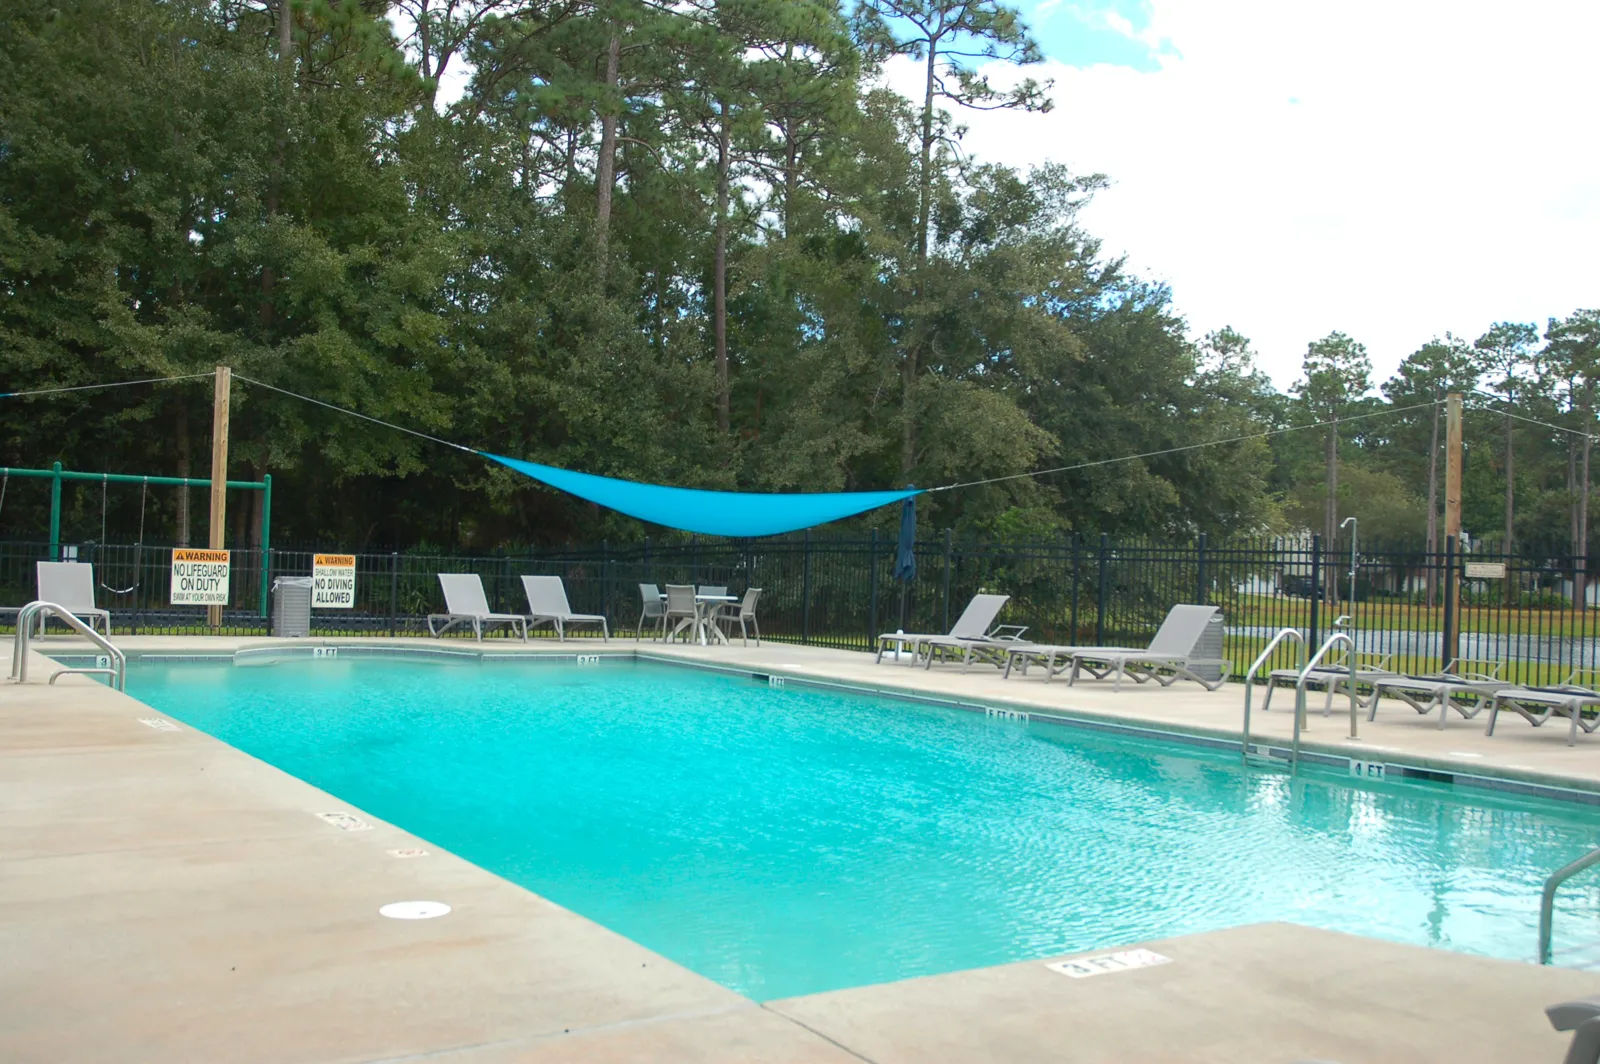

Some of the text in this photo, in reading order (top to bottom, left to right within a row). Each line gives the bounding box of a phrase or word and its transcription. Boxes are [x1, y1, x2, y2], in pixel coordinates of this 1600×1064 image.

[185, 552, 227, 561] WARNING
[325, 556, 353, 565] WARNING
[174, 563, 227, 577] NO LIFEGUARD
[315, 568, 353, 577] SHALLOW WATER
[181, 577, 220, 591] ON DUTY
[315, 578, 353, 590] NO DIVING
[173, 592, 226, 602] SWIM AT YOUR OWN RISK
[316, 592, 350, 603] ALLOWED
[326, 648, 336, 656] FT
[101, 657, 107, 666] 3
[1354, 763, 1383, 778] 4 FT
